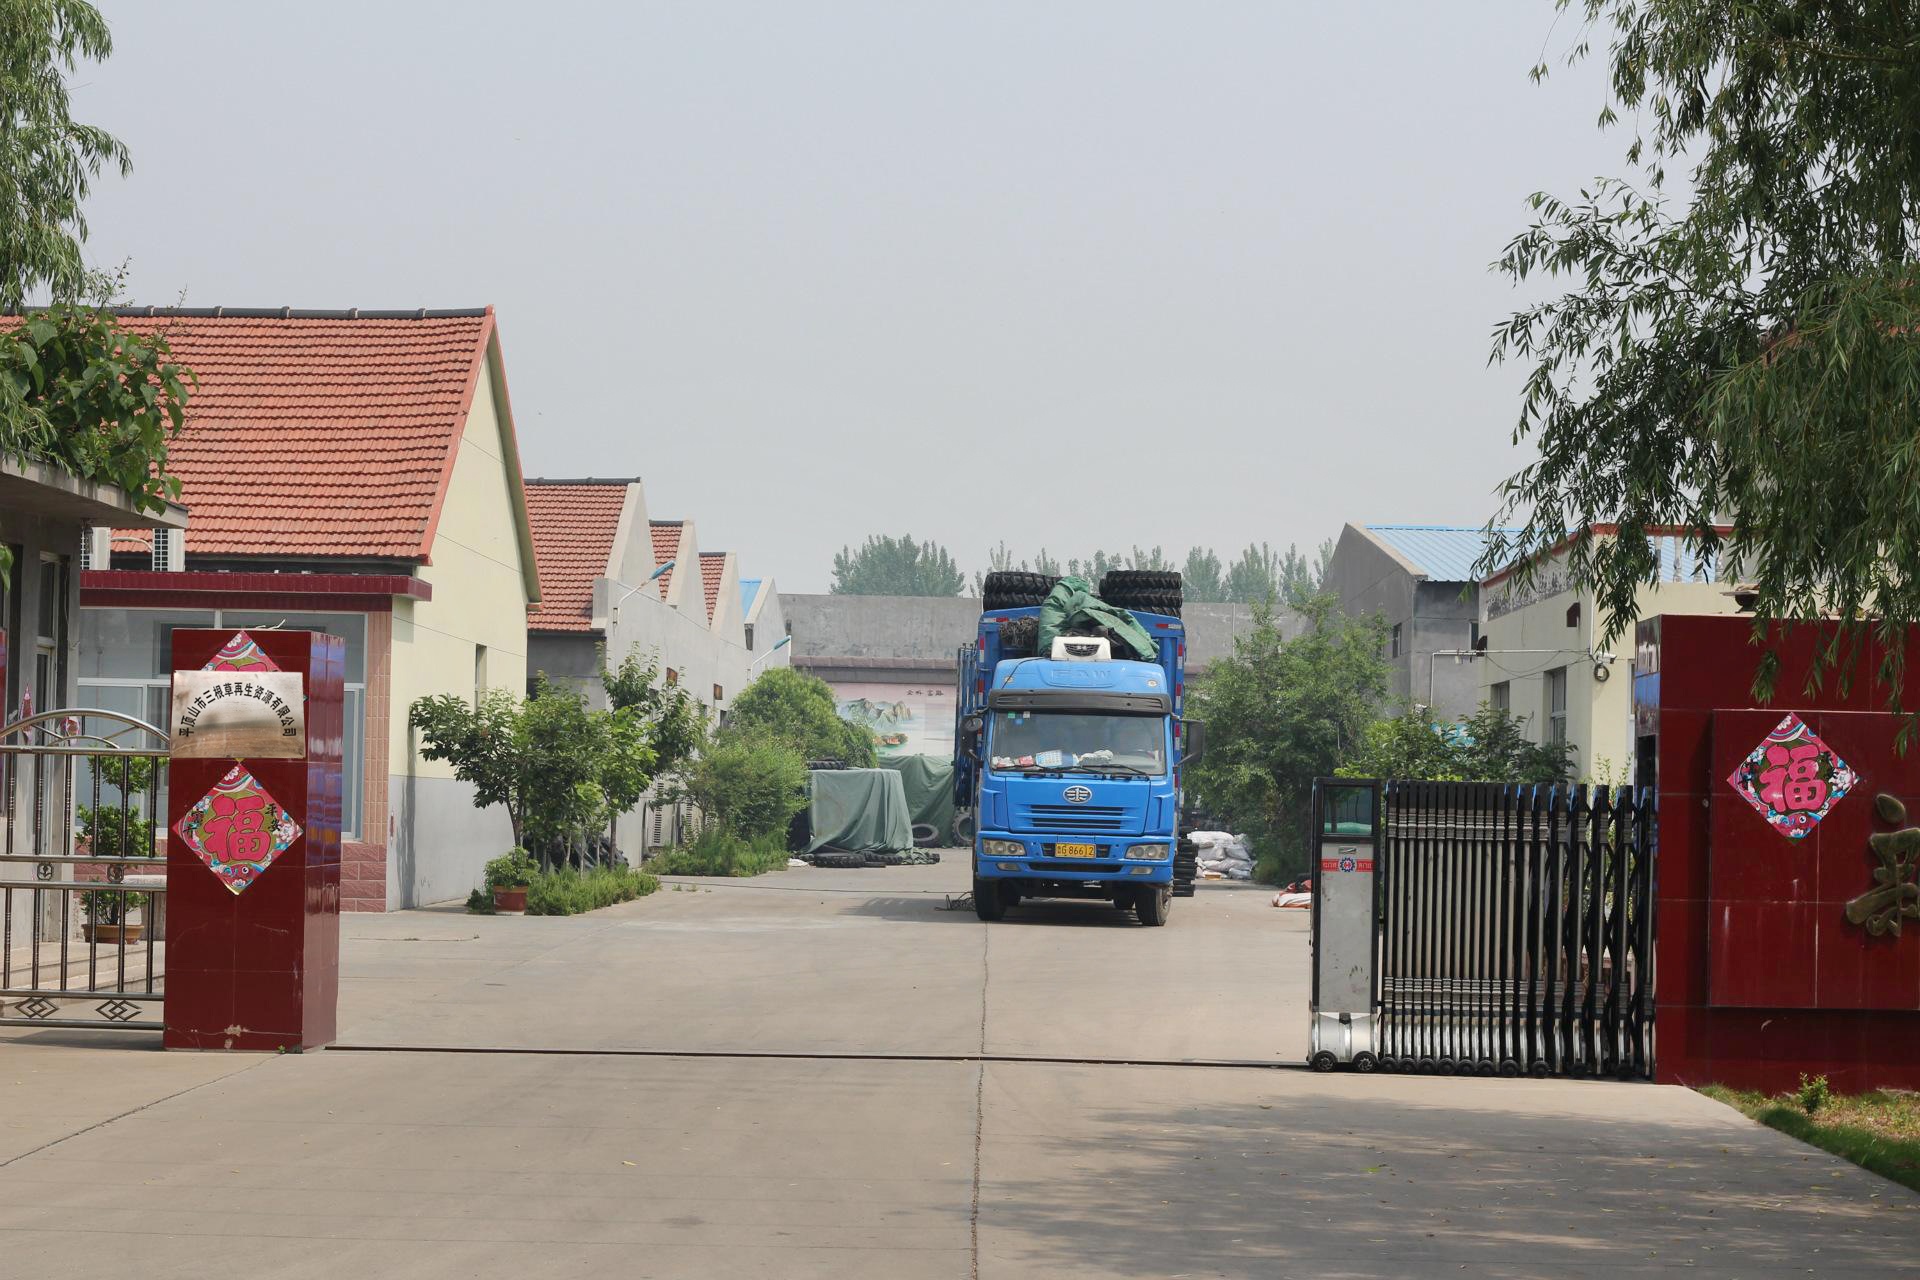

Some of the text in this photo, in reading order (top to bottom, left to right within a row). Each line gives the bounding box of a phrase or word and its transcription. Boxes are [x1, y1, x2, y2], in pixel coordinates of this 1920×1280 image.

[178, 681, 297, 738] 平顶山市三根草再生资源有限公司
[1758, 743, 1828, 813] 福
[203, 793, 272, 863] 福
